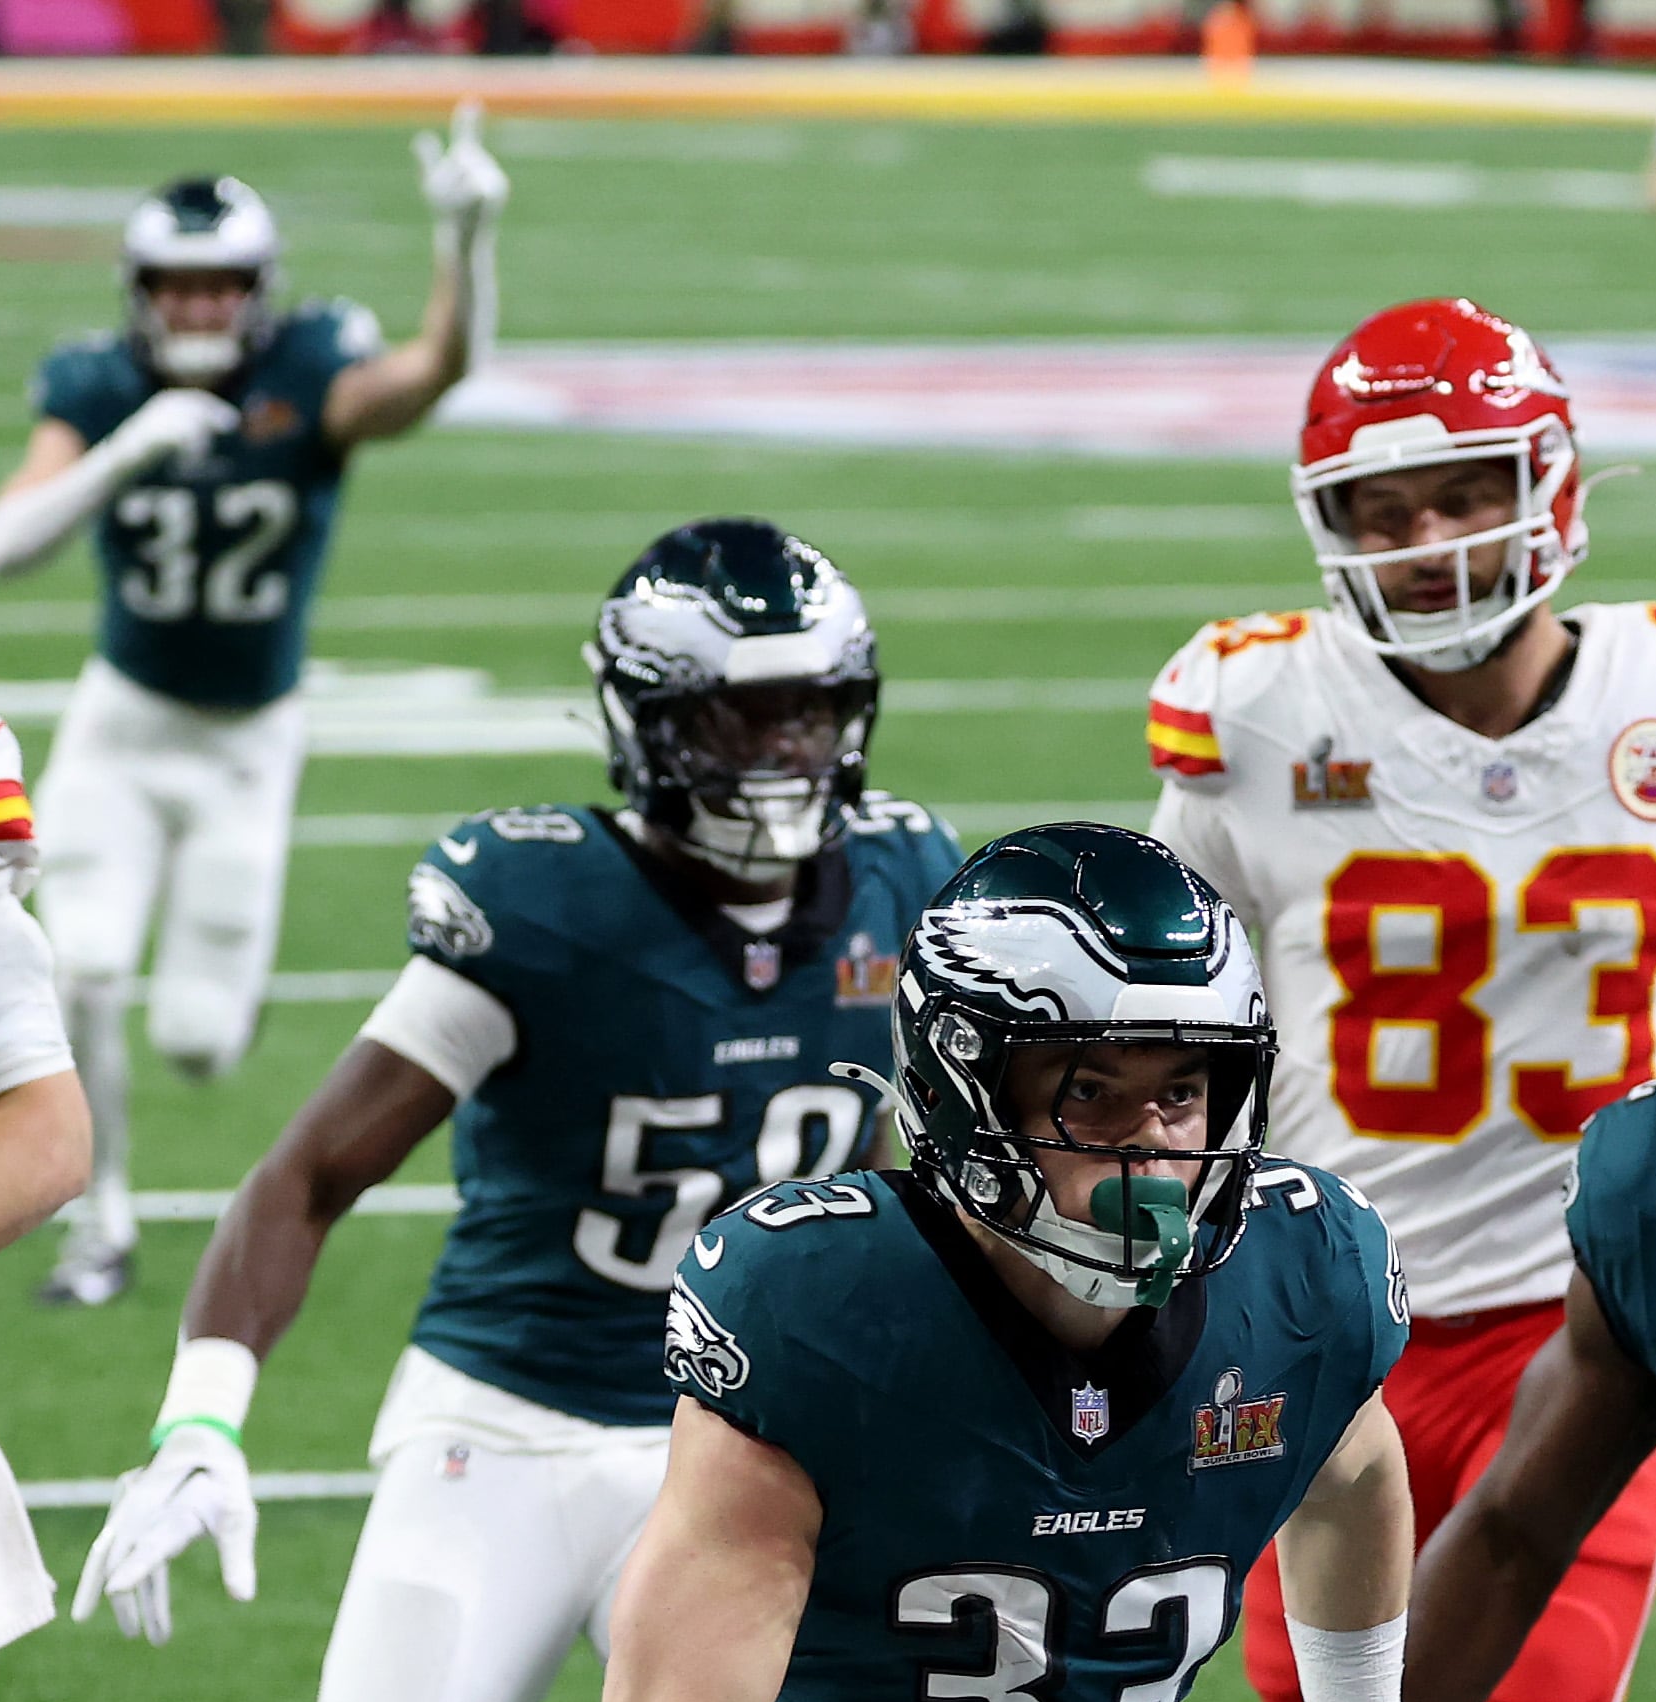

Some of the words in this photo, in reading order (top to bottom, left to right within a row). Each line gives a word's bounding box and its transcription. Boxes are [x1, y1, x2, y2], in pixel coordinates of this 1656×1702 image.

[115, 480, 298, 624] 32
[1077, 1409, 1104, 1432] NFL
[1194, 1396, 1286, 1459] LIX
[1201, 1452, 1241, 1466] SUPER
[1243, 1447, 1275, 1461] BOWL
[1031, 1508, 1147, 1537] EAGLES
